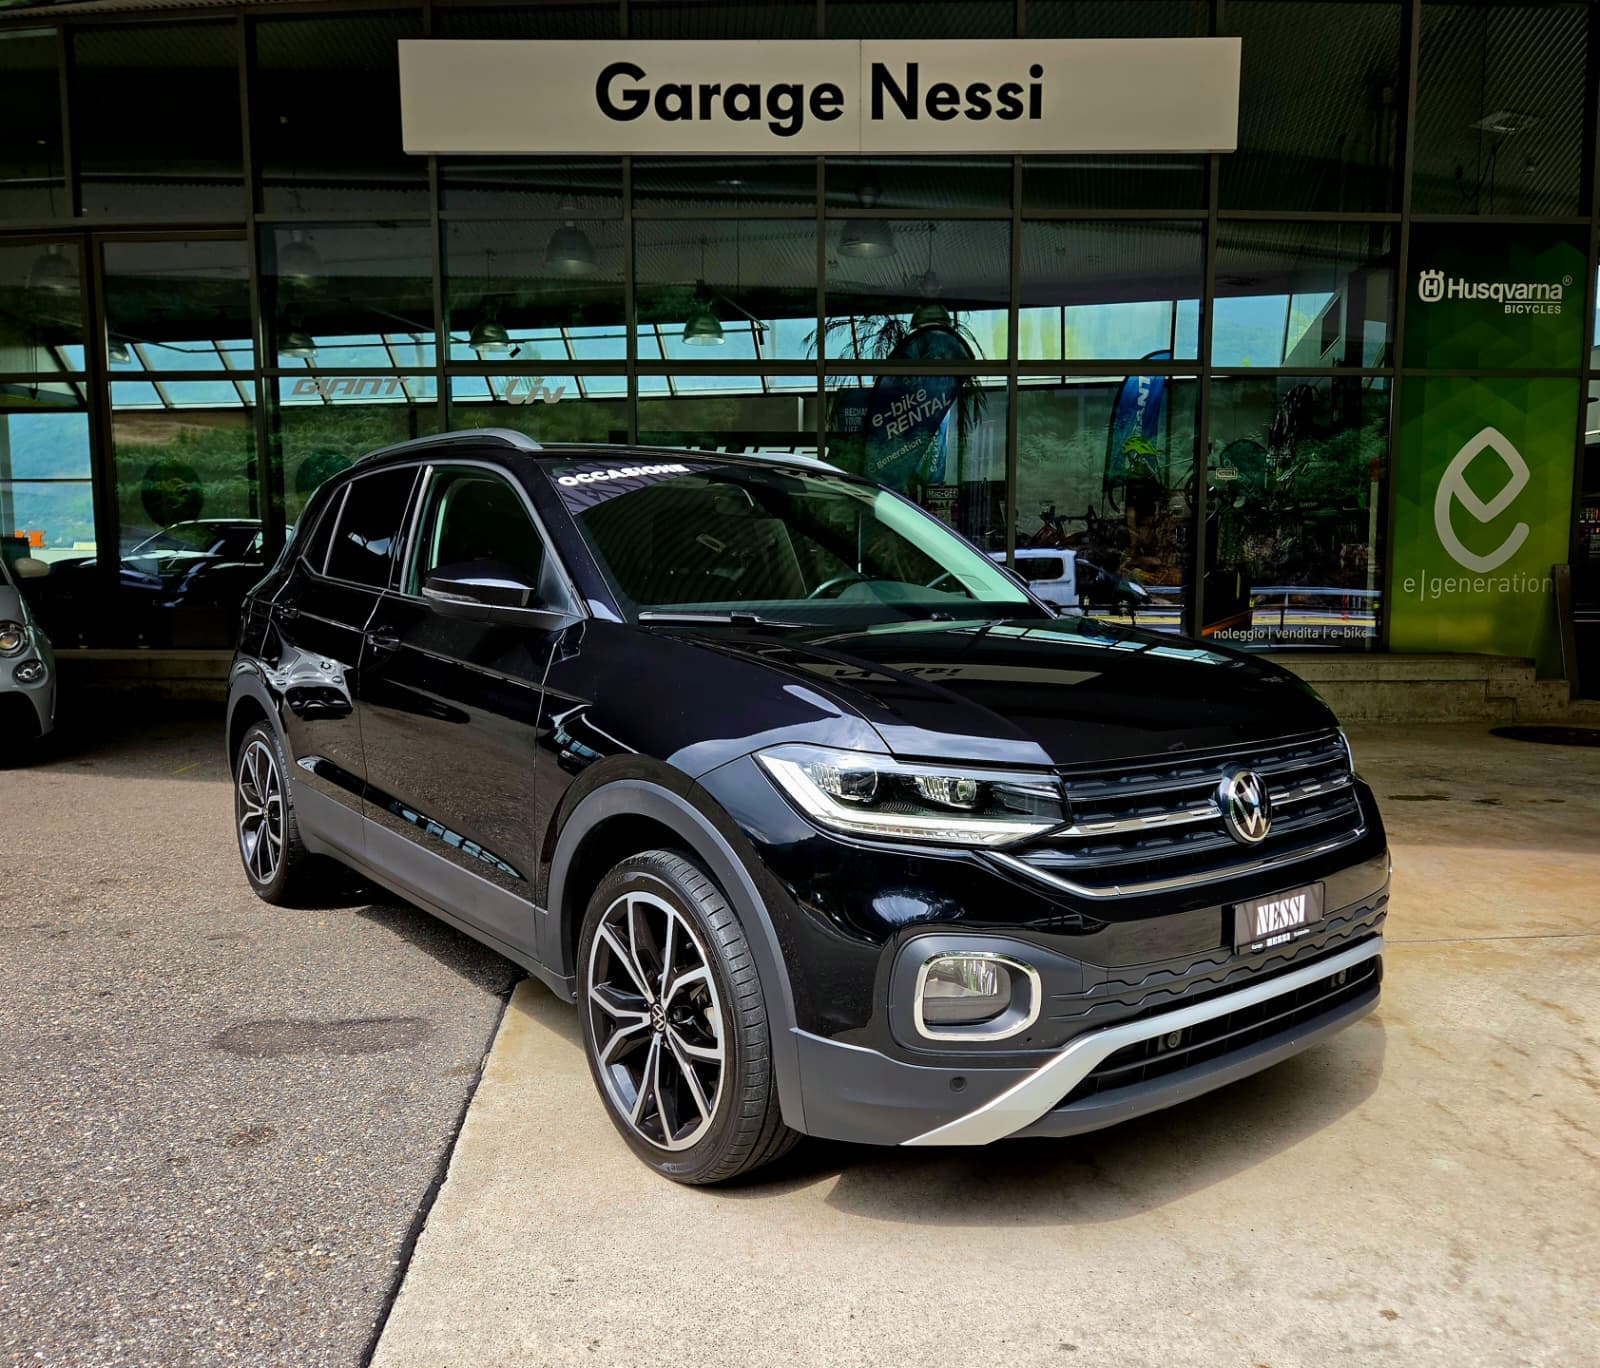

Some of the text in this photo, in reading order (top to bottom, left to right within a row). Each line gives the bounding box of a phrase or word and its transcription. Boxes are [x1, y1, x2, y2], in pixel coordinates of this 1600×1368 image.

[595, 61, 1045, 137] Garage Nessi
[1447, 277, 1563, 303] Husqvarna
[1504, 304, 1562, 314] BICYCLES
[291, 378, 408, 395] GIANT
[872, 388, 927, 427] e-bike
[886, 392, 952, 440] RENTAL
[1213, 628, 1265, 642] noleggio
[1275, 628, 1318, 639] vendita
[1330, 627, 1369, 639] e-bike
[1256, 894, 1306, 936] NESSI
